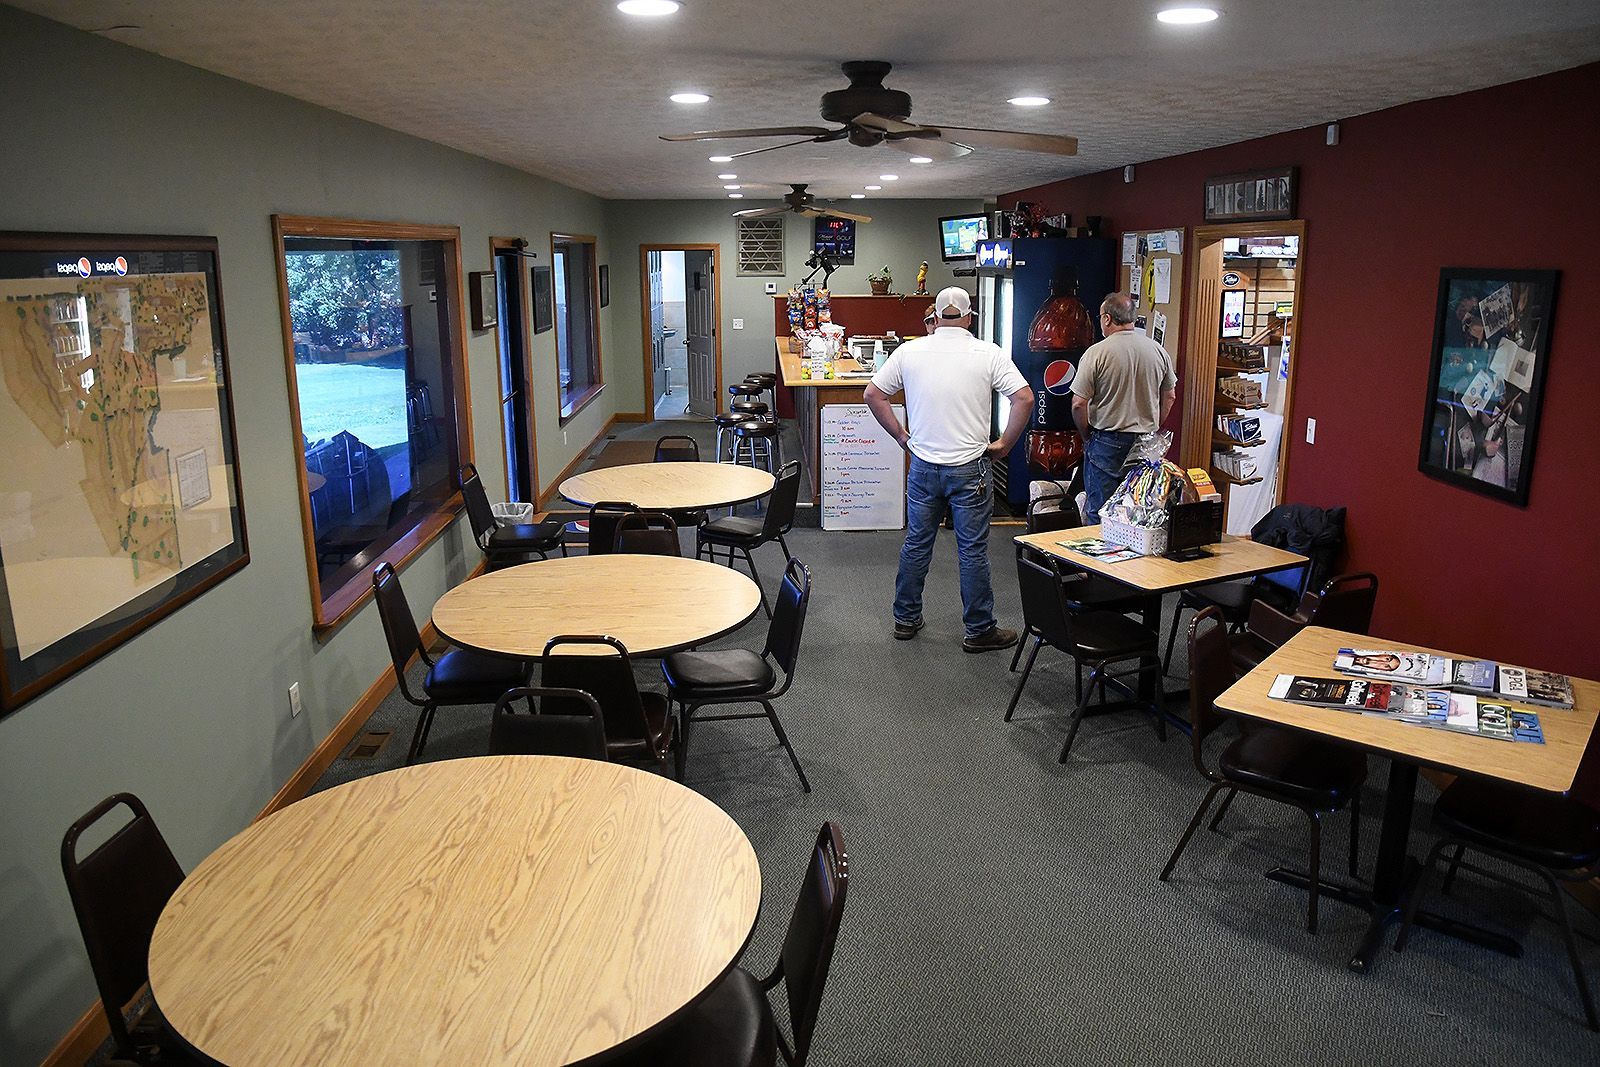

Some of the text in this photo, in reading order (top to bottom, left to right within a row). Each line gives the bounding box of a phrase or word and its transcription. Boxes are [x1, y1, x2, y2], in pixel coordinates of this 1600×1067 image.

[1038, 391, 1047, 424] pepsi
[1345, 680, 1367, 706] Golfweek
[1509, 674, 1523, 691] PGA
[1481, 704, 1506, 735] GOLF
[1513, 711, 1542, 743] GOLF
